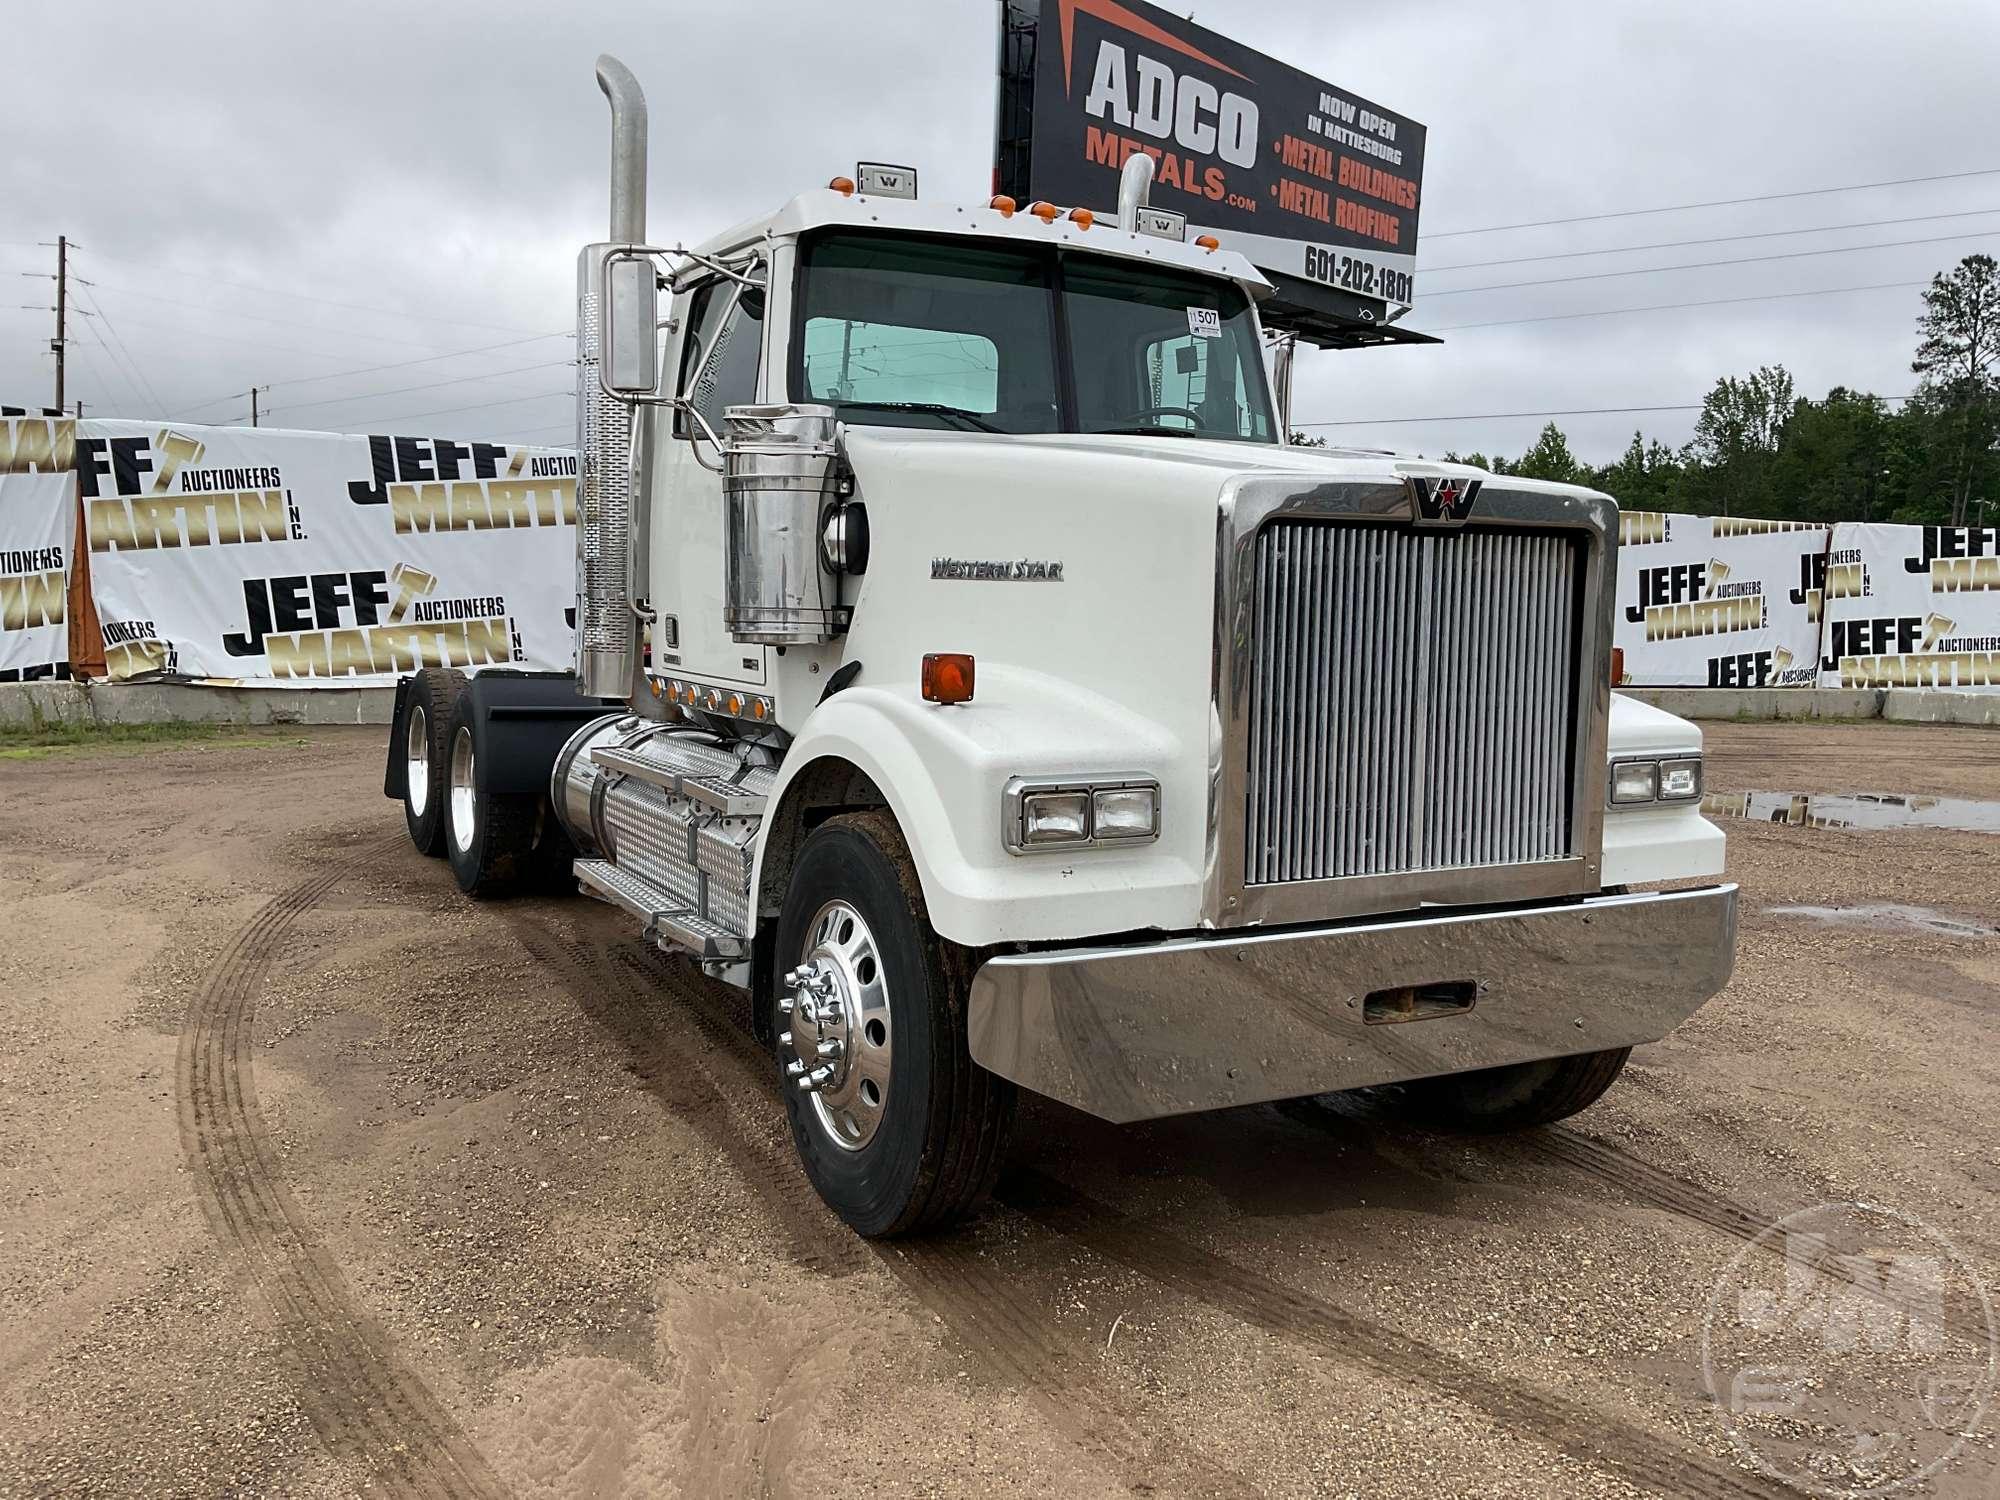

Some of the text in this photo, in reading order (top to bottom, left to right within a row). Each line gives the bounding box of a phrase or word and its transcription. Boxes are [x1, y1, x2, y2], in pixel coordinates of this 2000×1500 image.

[1085, 39, 1259, 169] ADCO
[1319, 92, 1396, 142] NOW OPEN
[1307, 114, 1403, 166] IN HATTIESBURG
[1282, 134, 1417, 210] METAL BUILDINGS
[1279, 178, 1400, 245] METAL ROOFING
[1305, 245, 1413, 303] 601-202-1801
[181, 467, 281, 492] AUCTIONEERS
[1013, 558, 1064, 582] STAR
[1625, 563, 1706, 622] JEFF
[1717, 580, 1762, 599] AUCTIONEERS
[223, 570, 390, 658] JEFF
[415, 597, 505, 621] AUCTIONEERS
[1646, 597, 1761, 642] MARTIN
[266, 618, 510, 678] MARTIN
[1821, 617, 1922, 672] JEFF
